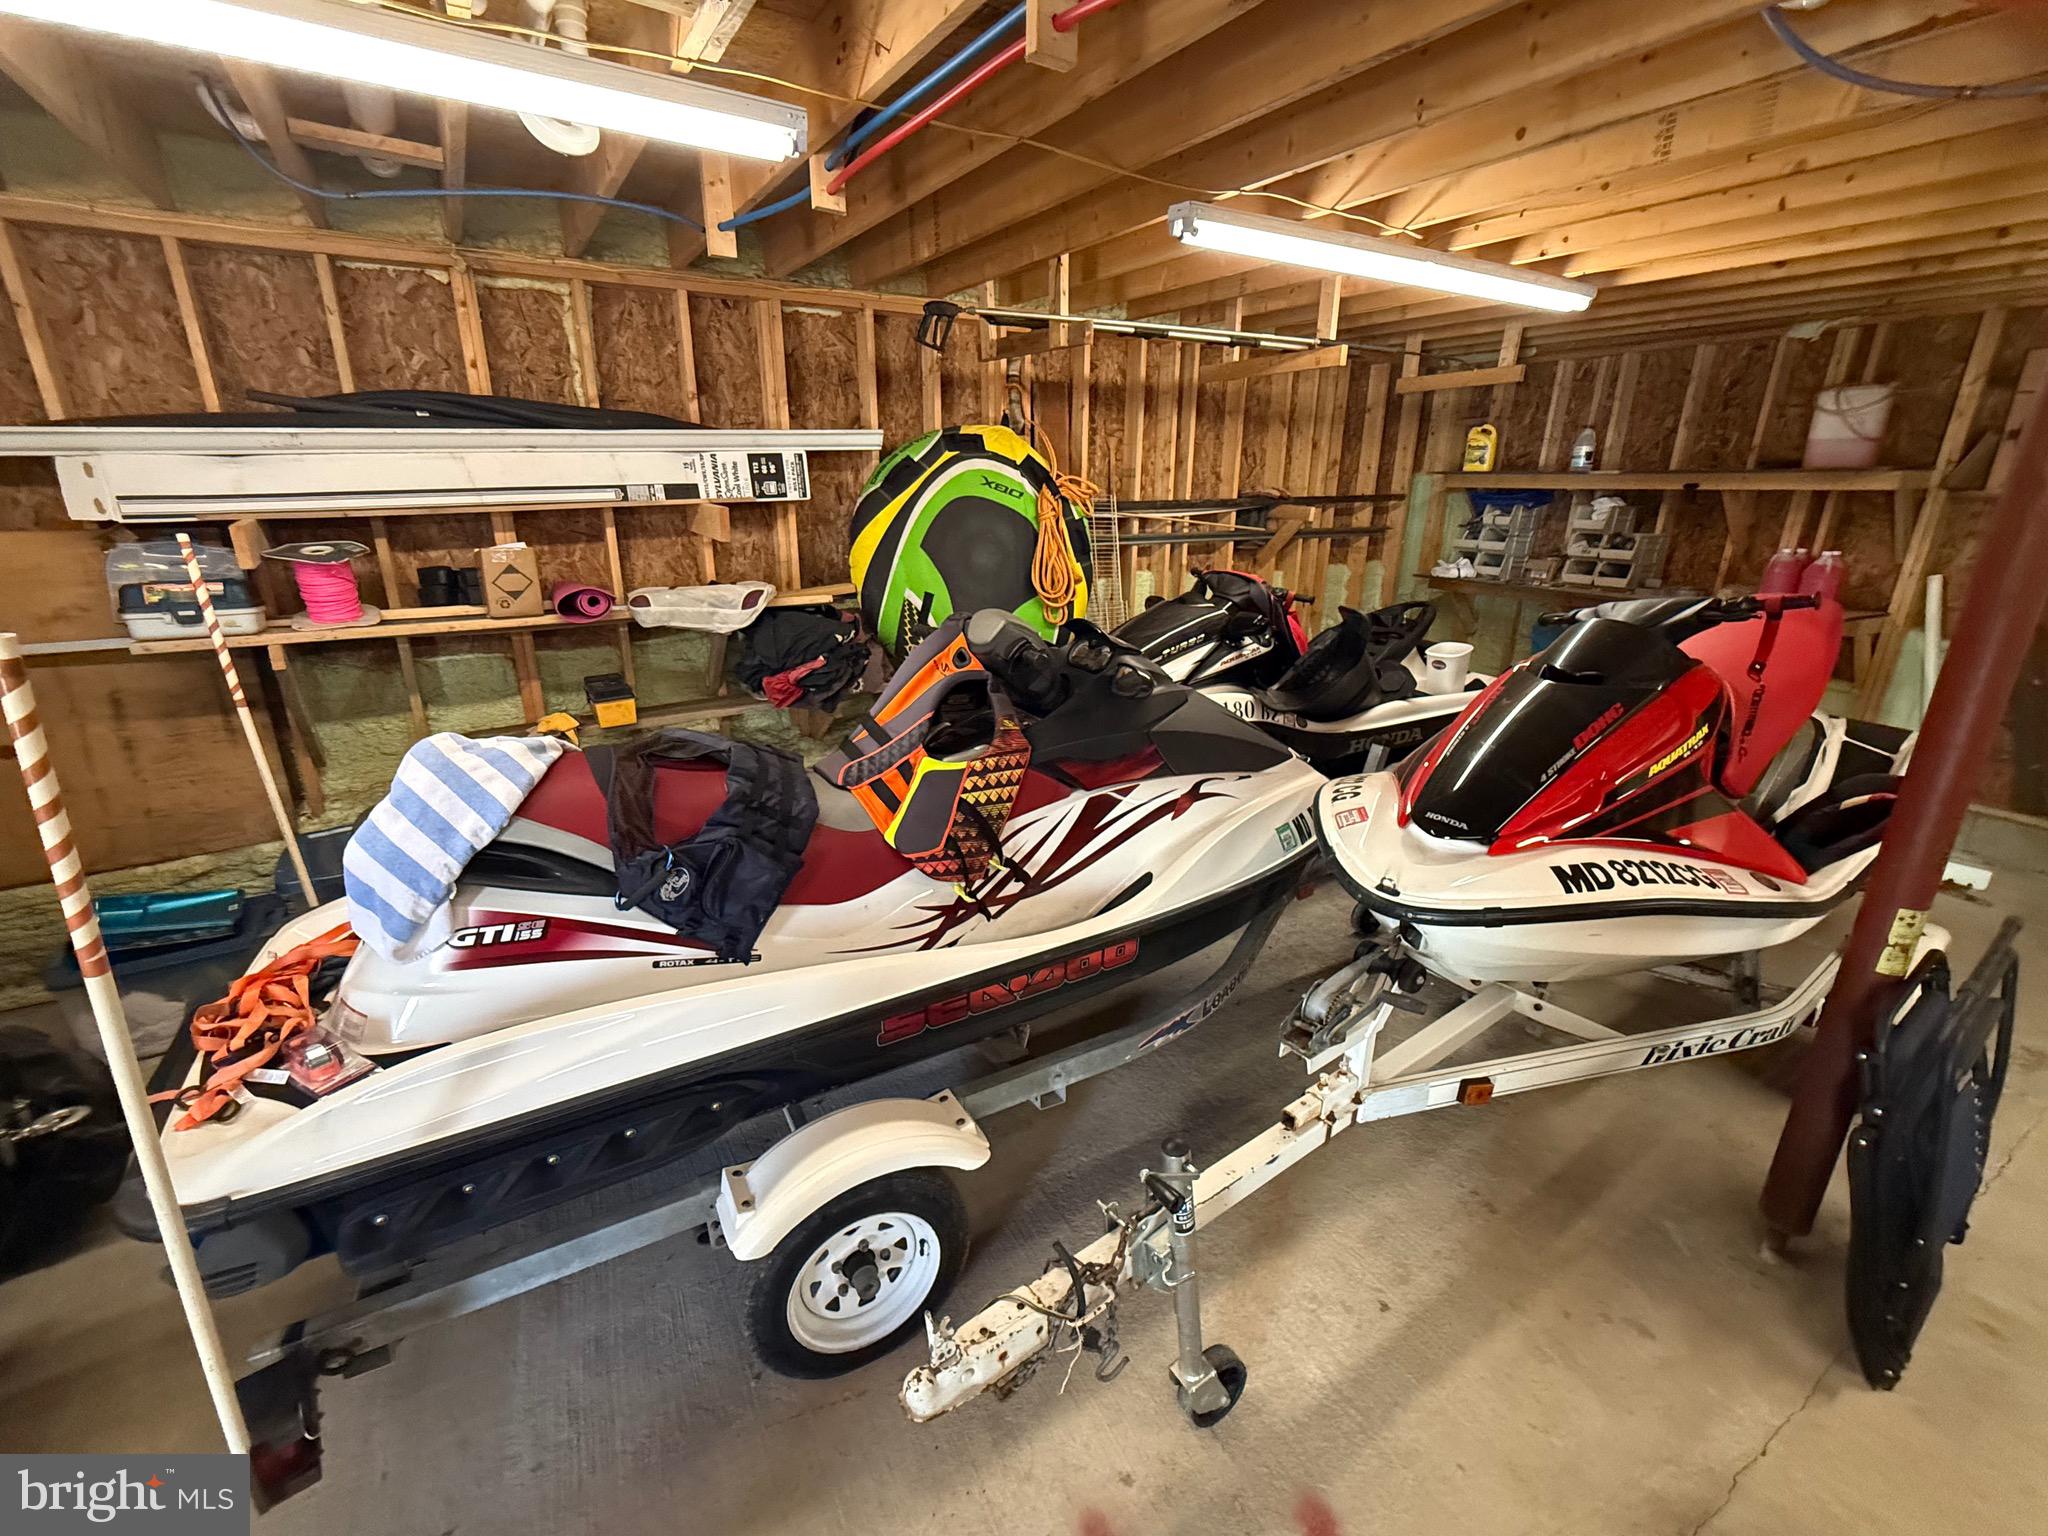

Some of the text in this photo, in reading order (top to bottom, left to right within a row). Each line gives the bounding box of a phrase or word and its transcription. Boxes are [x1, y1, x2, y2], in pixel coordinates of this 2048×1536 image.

[1648, 722, 1710, 778] AQUATRAX
[1424, 810, 1470, 831] HONDA
[1549, 861, 1616, 895] MD
[1607, 858, 1721, 890] 8212CG
[447, 922, 516, 947] GTI
[659, 958, 695, 968] ROTAX
